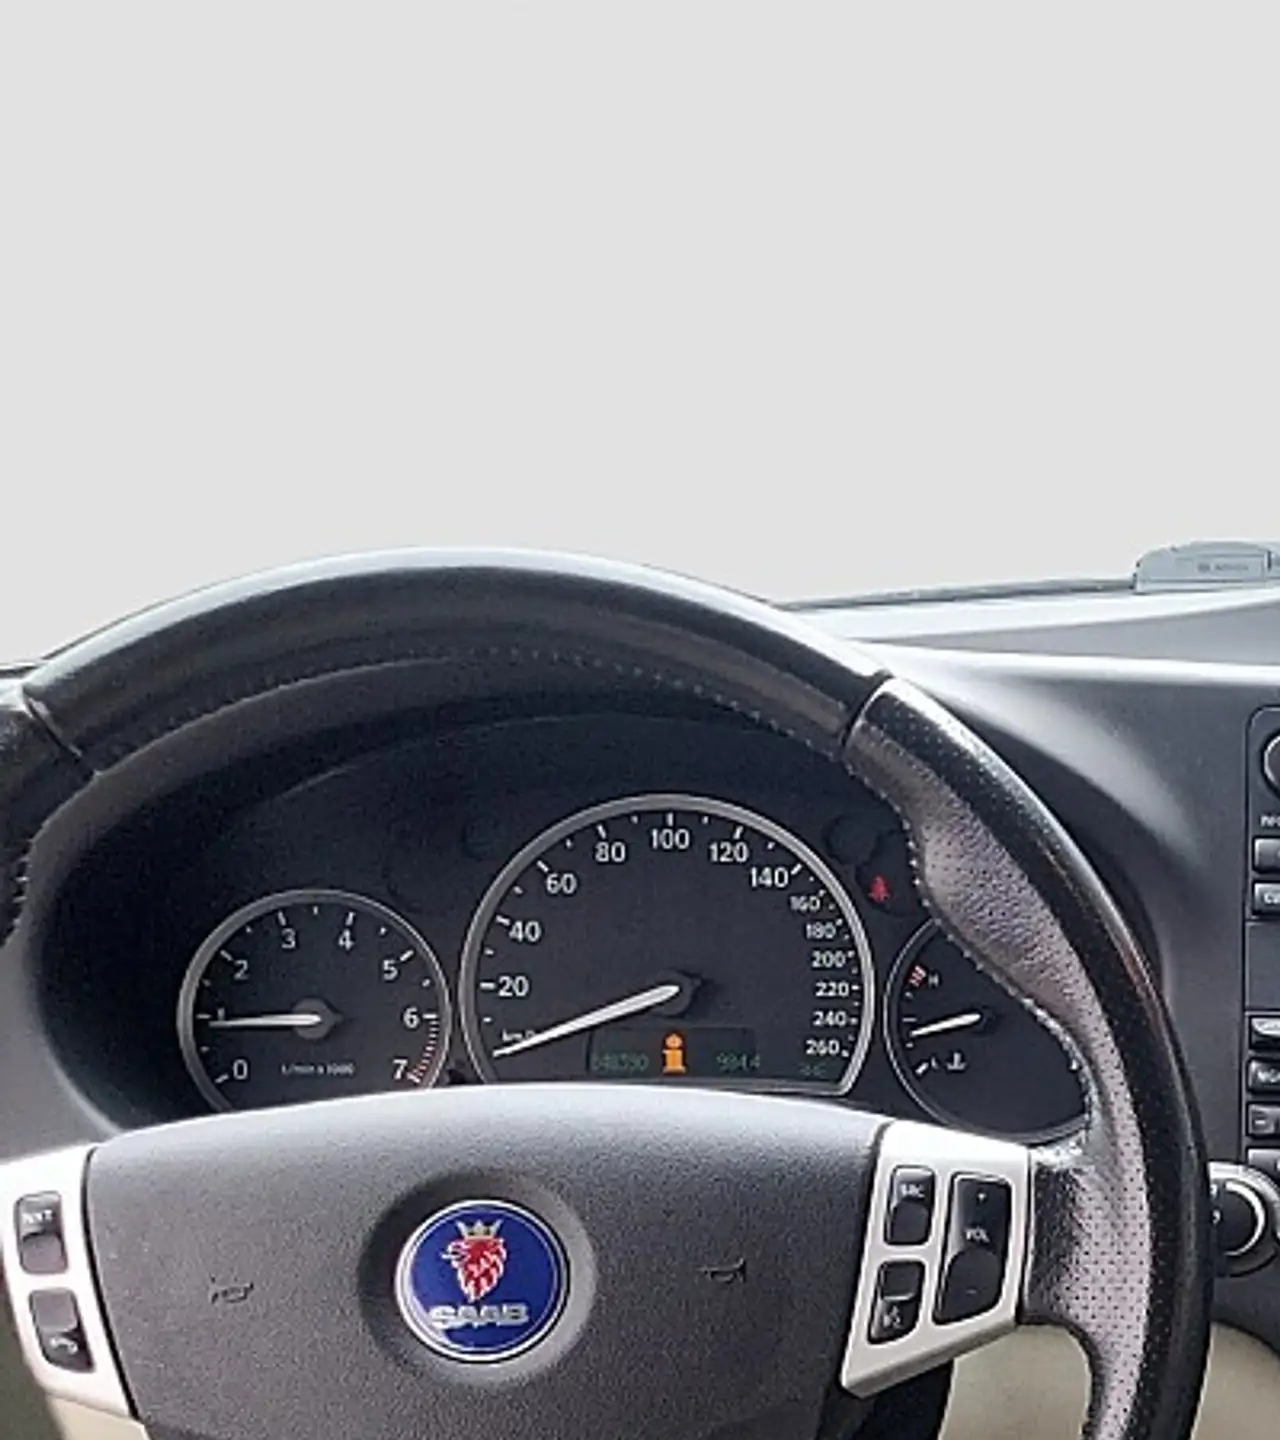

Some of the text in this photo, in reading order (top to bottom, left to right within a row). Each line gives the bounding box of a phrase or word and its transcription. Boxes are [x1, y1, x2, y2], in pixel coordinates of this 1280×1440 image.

[651, 827, 690, 851] 100
[595, 841, 627, 863] 80
[709, 841, 750, 863] 120
[545, 872, 578, 895] 60
[750, 866, 790, 888] 140
[789, 895, 822, 912] 160
[281, 928, 297, 950] 3
[338, 928, 354, 950] 4
[508, 920, 542, 943] 40
[805, 921, 836, 938] 180
[233, 959, 249, 981] 2
[382, 959, 399, 981] 5
[811, 951, 846, 968] 200
[498, 975, 530, 997] 20
[815, 981, 849, 997] 220
[403, 1006, 420, 1029] 6
[813, 1010, 847, 1027] 240
[805, 1039, 840, 1056] 260
[232, 1059, 249, 1081] 0
[392, 1059, 409, 1081] 7
[428, 1302, 530, 1330] SAAB
